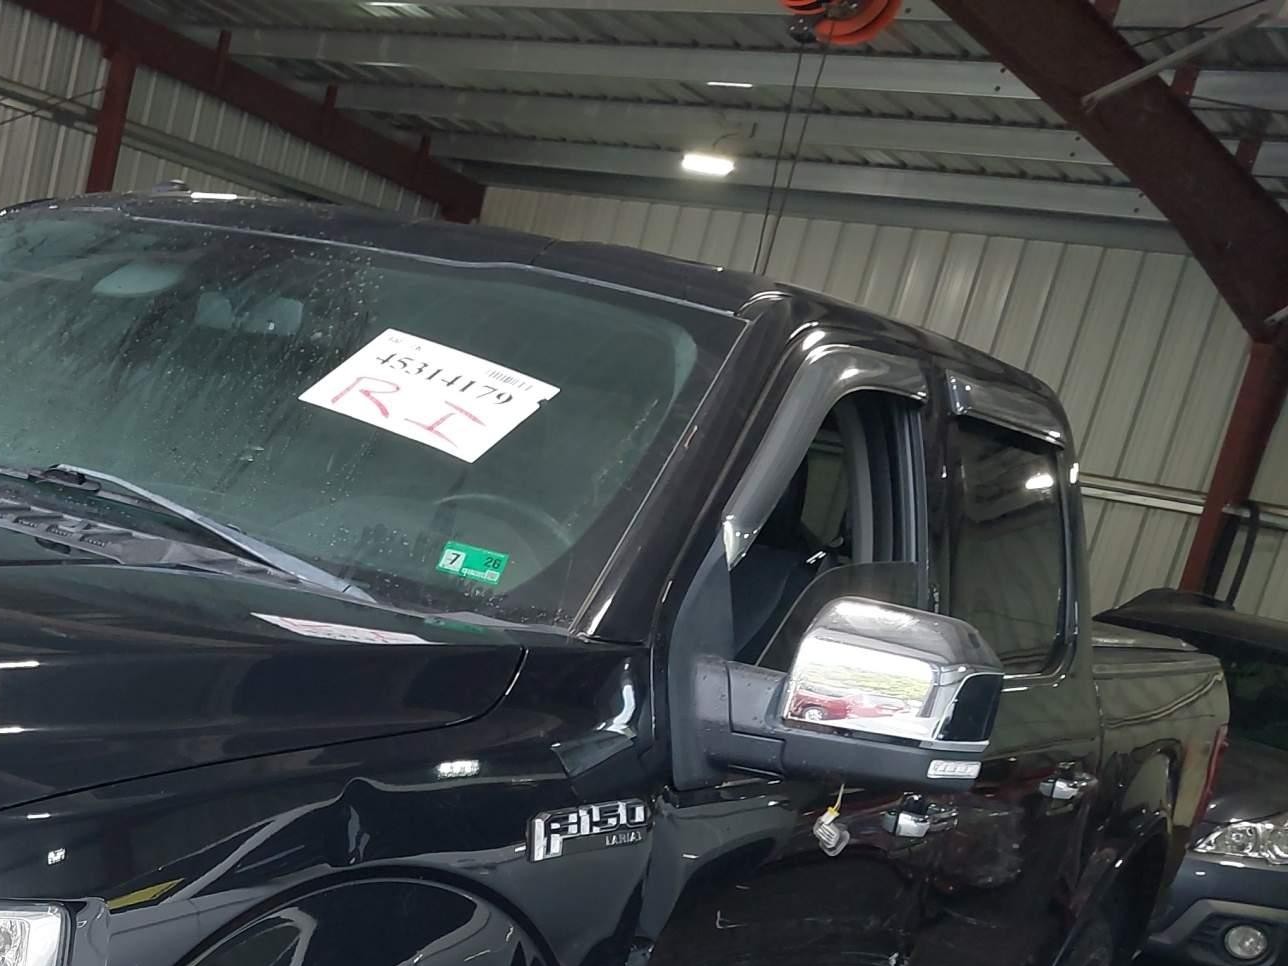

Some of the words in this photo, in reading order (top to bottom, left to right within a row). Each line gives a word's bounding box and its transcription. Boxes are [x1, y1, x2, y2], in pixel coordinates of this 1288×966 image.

[376, 352, 513, 405] 45314179
[330, 376, 400, 418] R
[404, 400, 487, 448] I
[449, 552, 461, 565] 7
